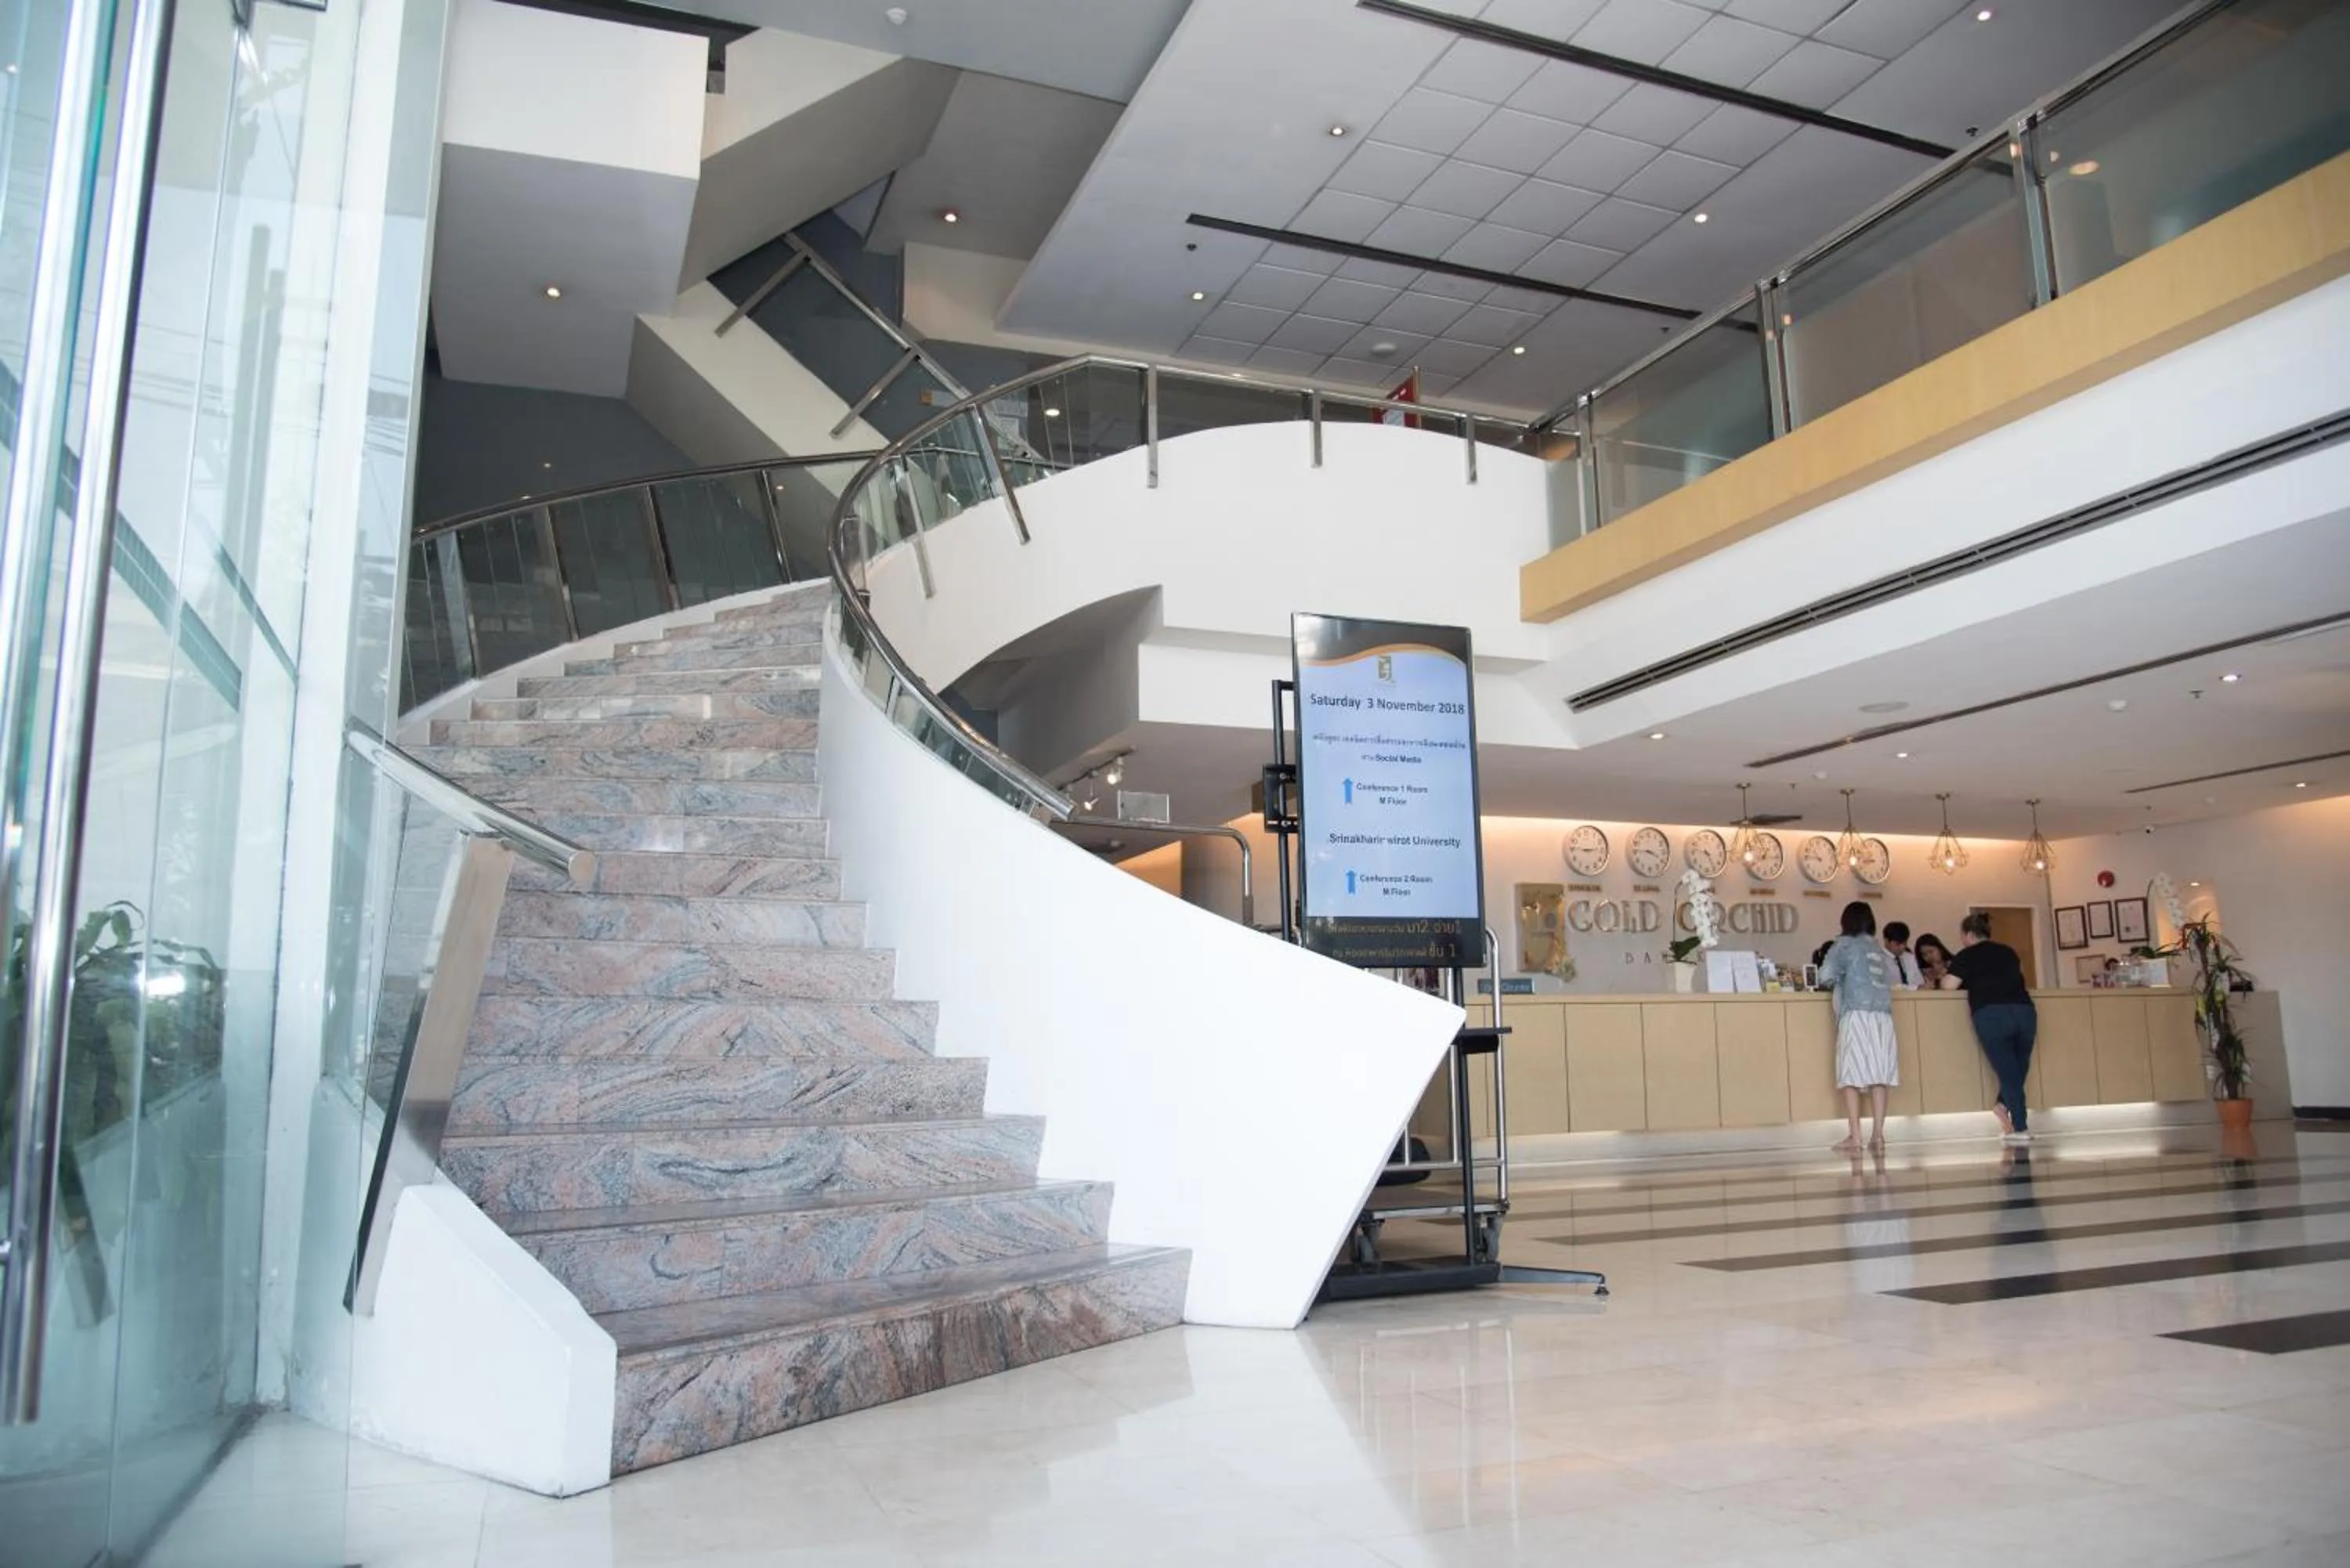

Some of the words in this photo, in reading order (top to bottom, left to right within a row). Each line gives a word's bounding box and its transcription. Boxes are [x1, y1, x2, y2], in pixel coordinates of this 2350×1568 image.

[1311, 693, 1361, 710] Saturday
[1367, 698, 1374, 709] 3
[1377, 699, 1435, 712] November
[1438, 703, 1465, 714] 2018
[1356, 783, 1398, 793] Conference
[1412, 836, 1461, 848] University
[1567, 900, 1662, 934] GOLD
